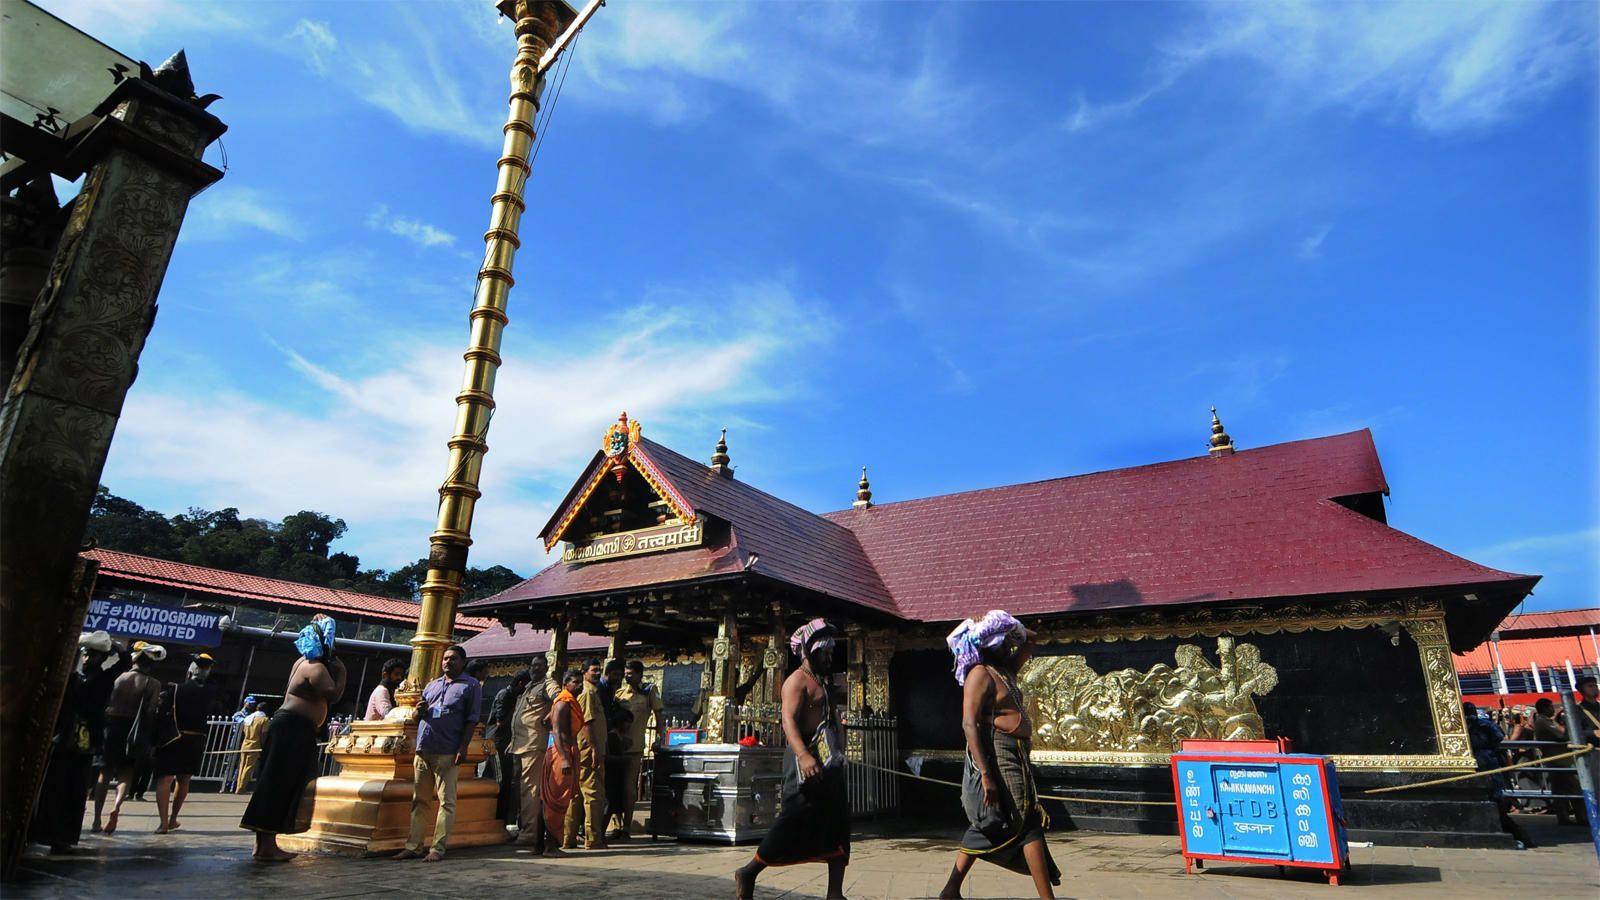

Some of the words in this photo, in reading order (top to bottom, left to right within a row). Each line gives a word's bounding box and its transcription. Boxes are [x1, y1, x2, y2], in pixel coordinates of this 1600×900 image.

[88, 600, 111, 615] NE
[110, 606, 122, 616] &
[123, 604, 217, 629] PHOTOGRAPHY
[106, 617, 196, 640] PROHIBITED
